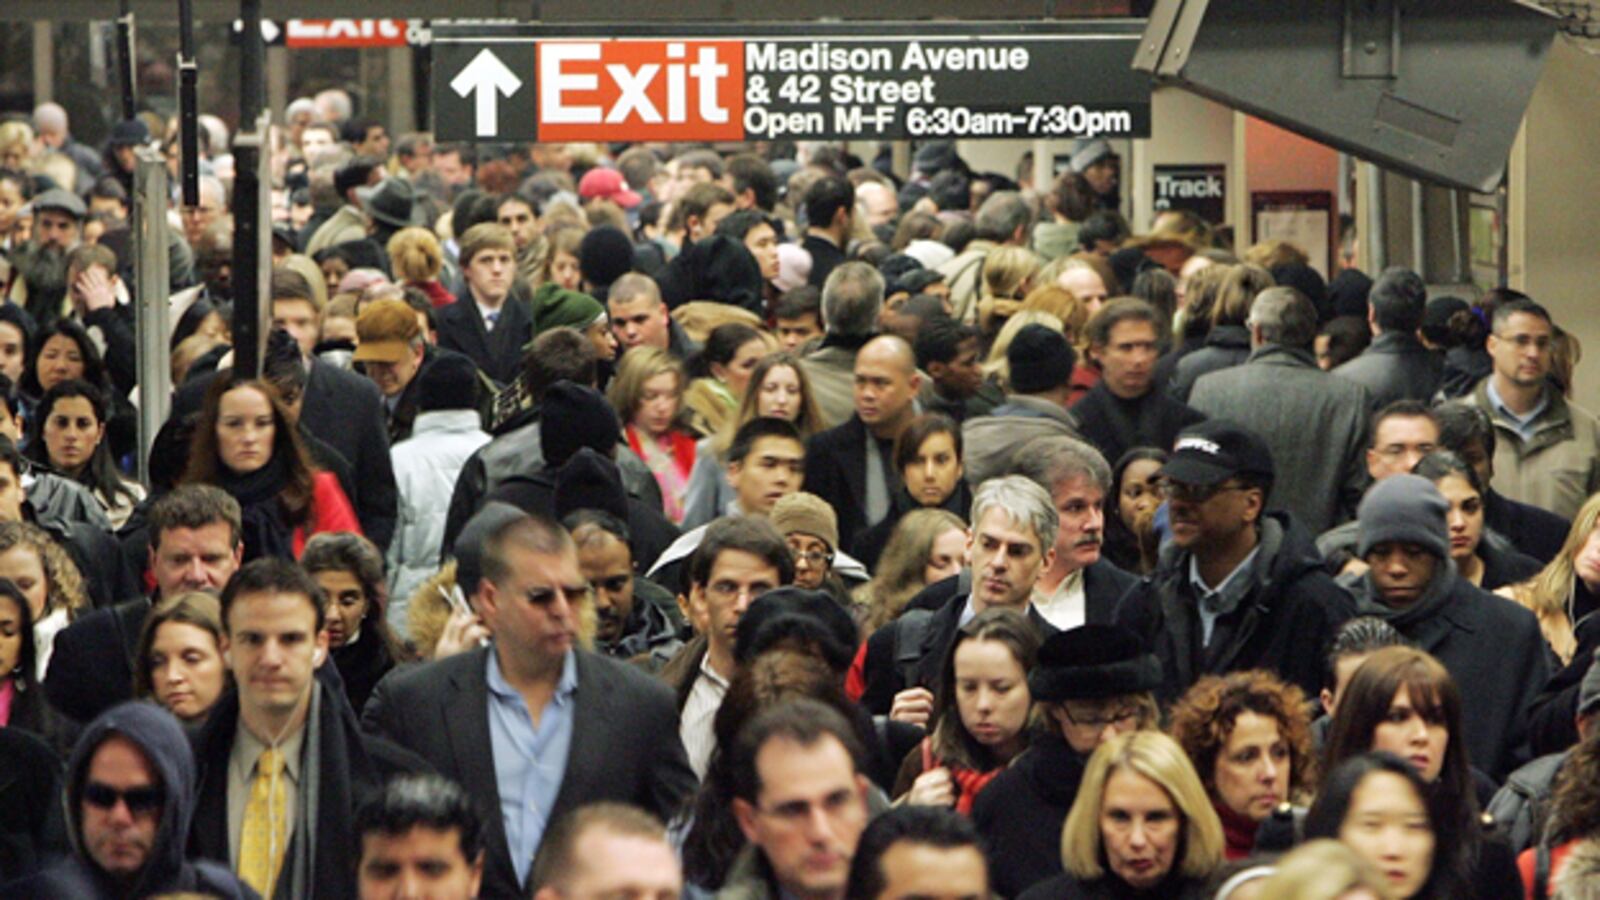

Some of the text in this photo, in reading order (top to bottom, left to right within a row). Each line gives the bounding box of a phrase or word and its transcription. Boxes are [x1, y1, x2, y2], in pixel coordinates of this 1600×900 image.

[745, 42, 1029, 71] Madison Avenue
[541, 43, 729, 124] Exit
[746, 75, 935, 103] & 42 Street
[744, 105, 1131, 138] Open M-F 6:30am-7:30pm
[1155, 175, 1222, 198] Track
